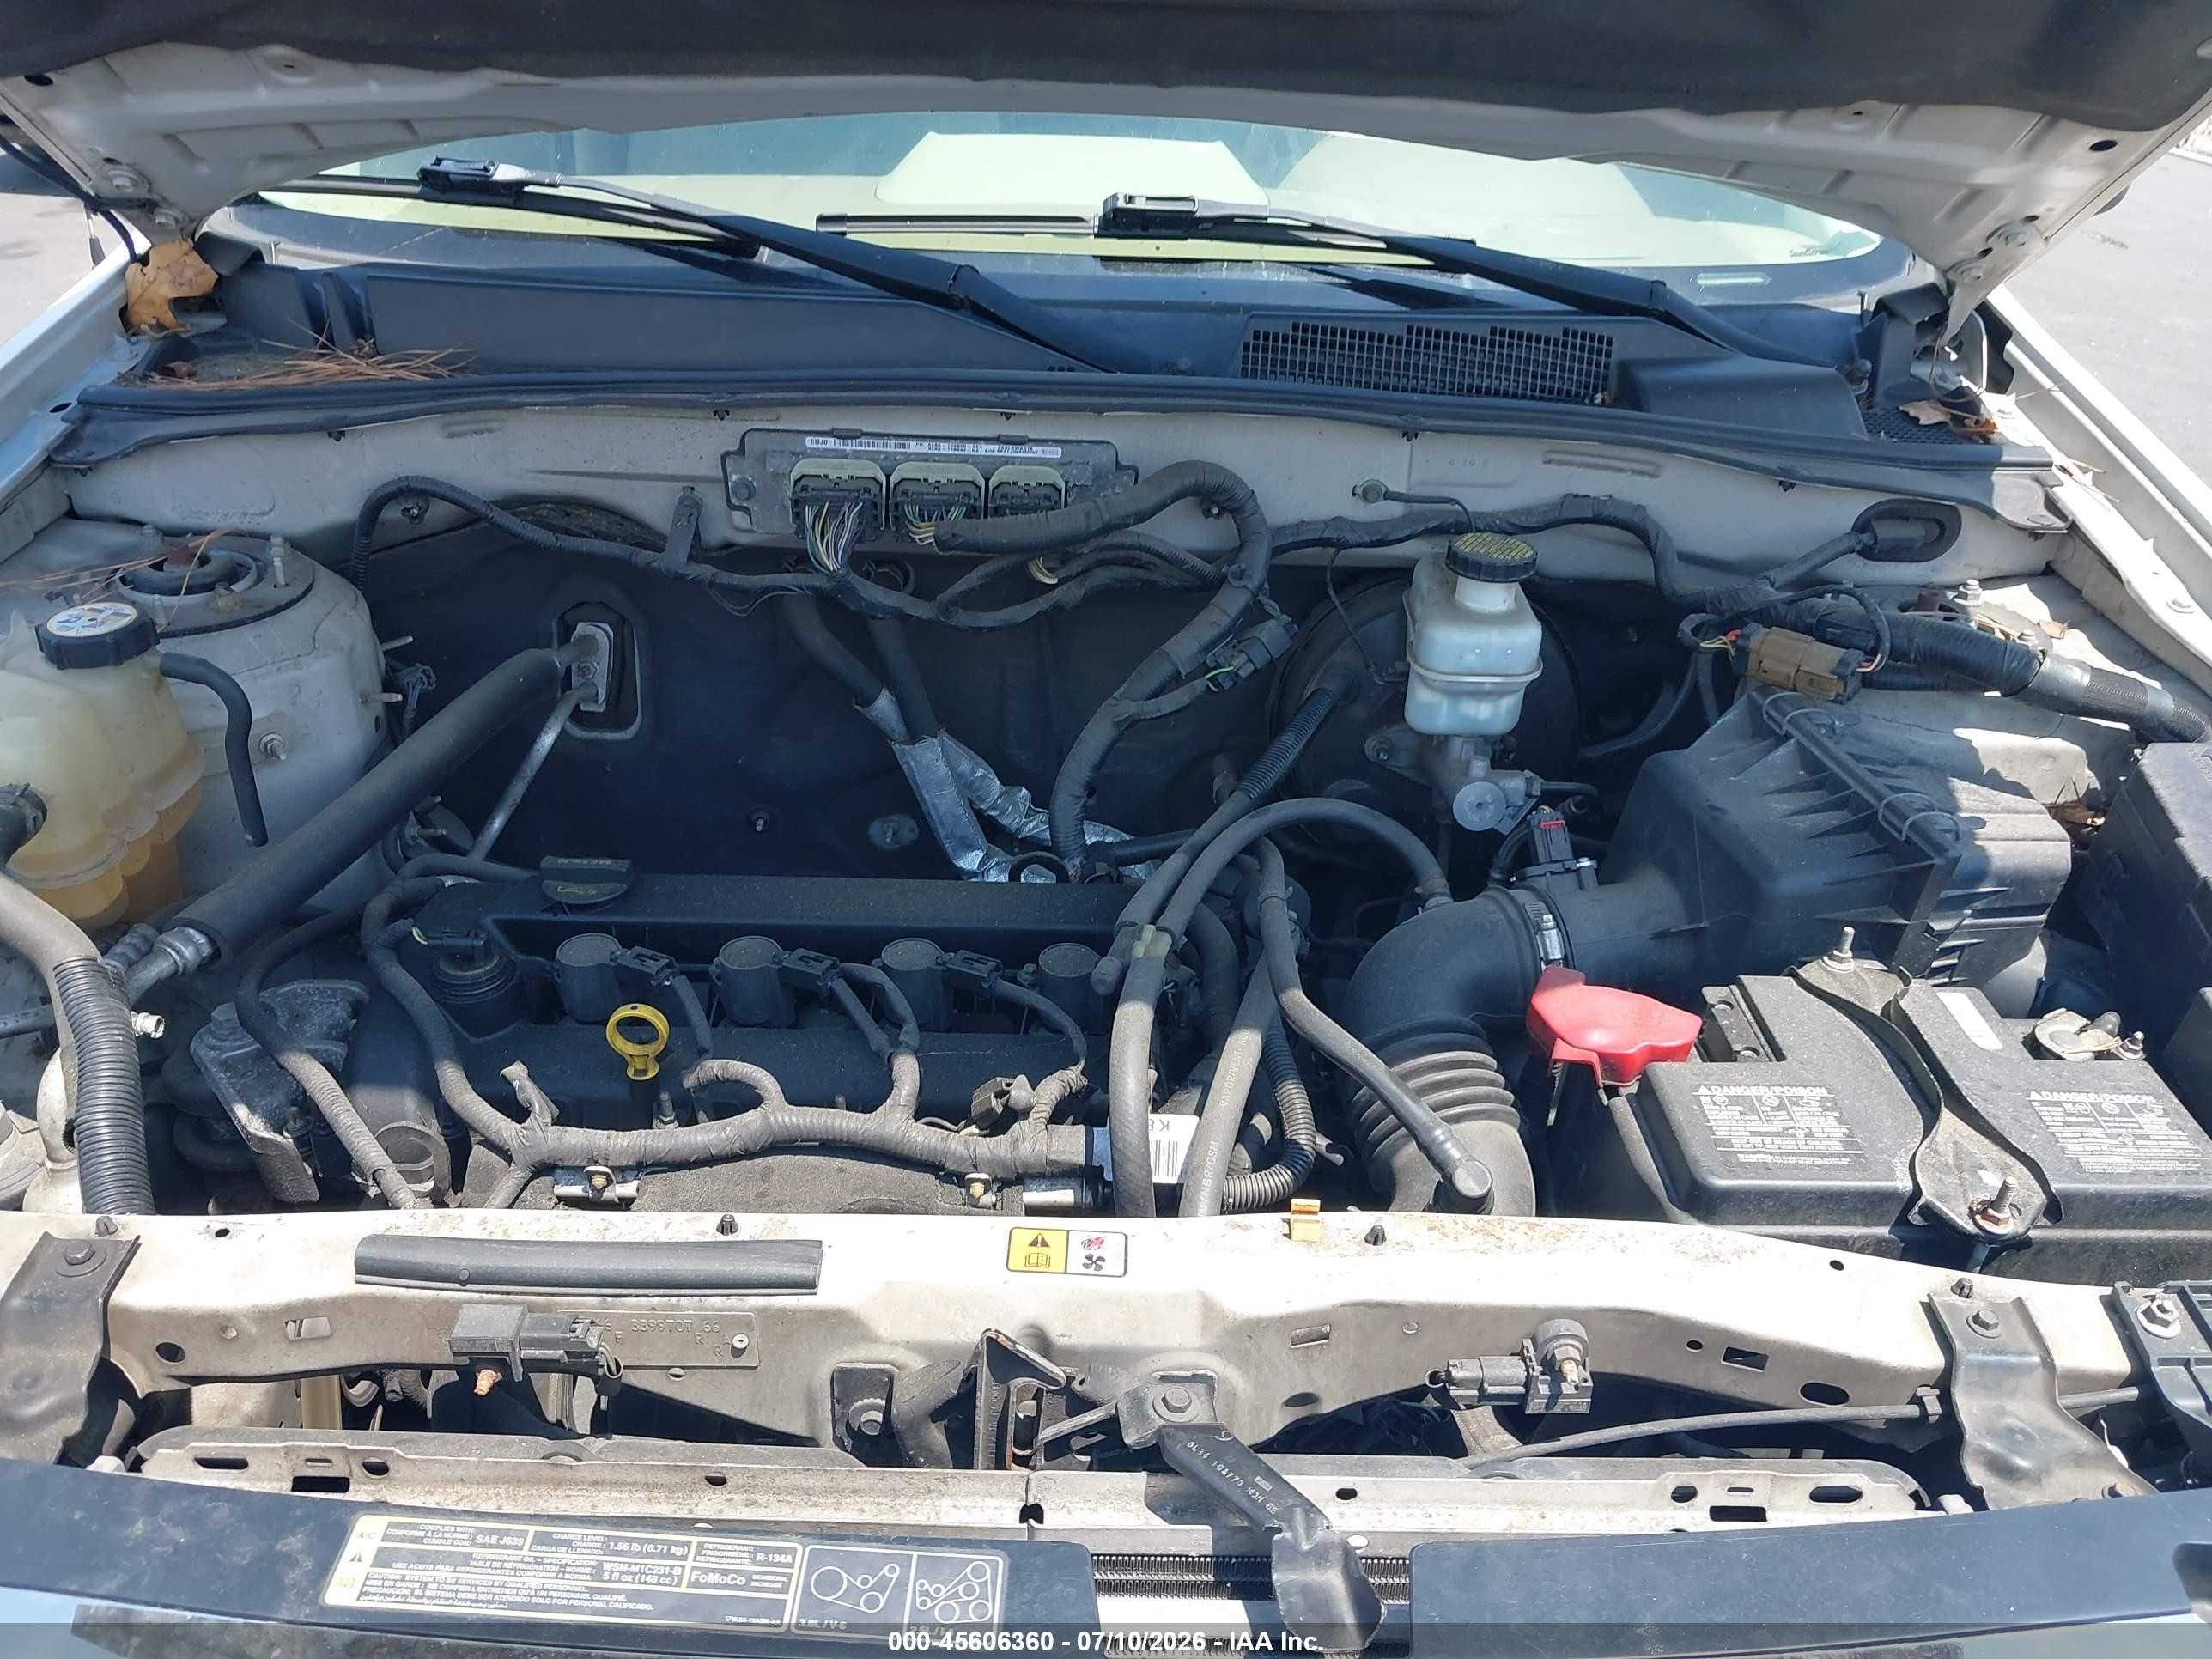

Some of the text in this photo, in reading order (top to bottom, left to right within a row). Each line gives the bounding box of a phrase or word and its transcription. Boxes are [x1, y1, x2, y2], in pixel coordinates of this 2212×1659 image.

[631, 1318, 693, 1333] 3399707
[475, 1534, 524, 1546] SAE J639
[631, 1543, 641, 1552] lb
[643, 1543, 667, 1553] (0.71
[670, 1545, 688, 1556] kg)
[756, 1553, 793, 1563] R-134A
[603, 1561, 682, 1576] WSH-M1C231-B
[602, 1571, 610, 1580] 5
[621, 1574, 634, 1583] oz
[635, 1573, 658, 1584] (148
[691, 1571, 746, 1585] FoMoCo
[798, 1618, 822, 1628] 3.0L
